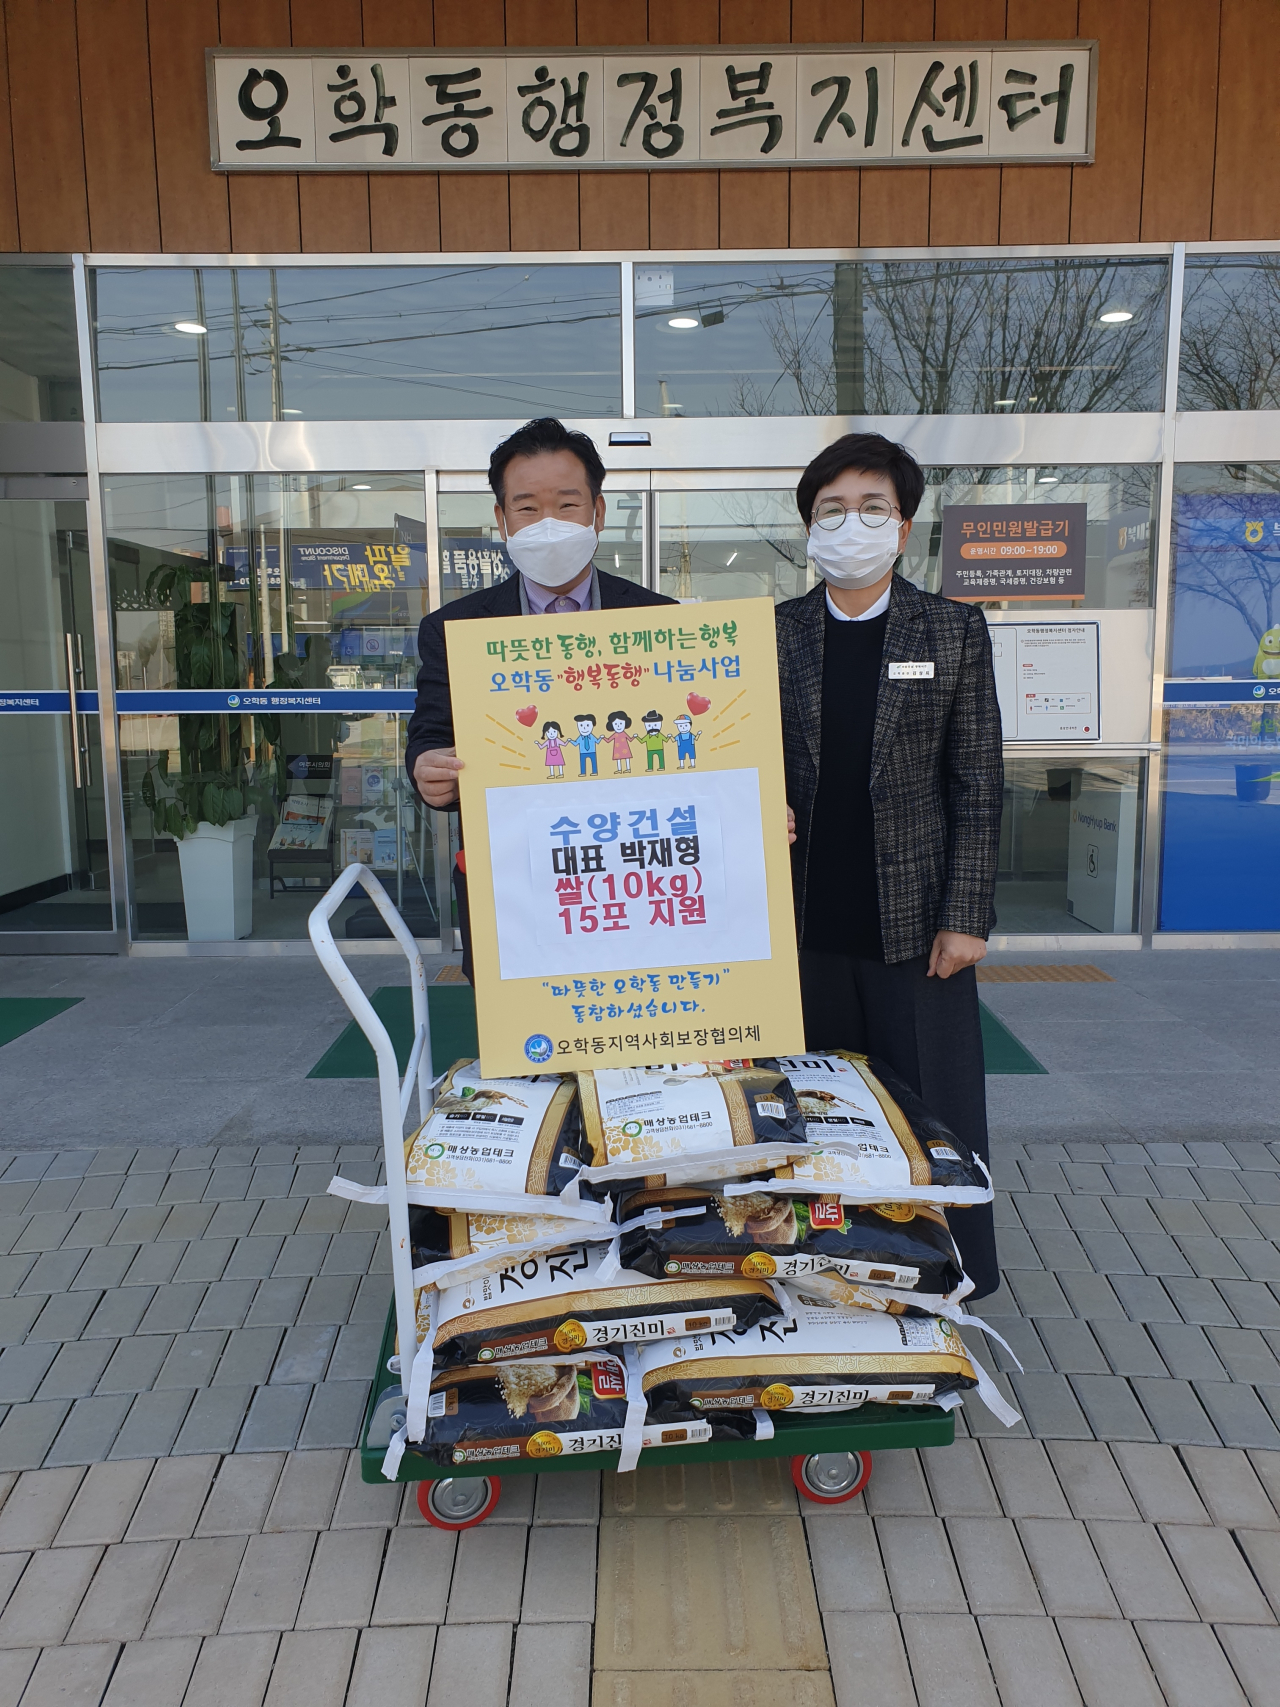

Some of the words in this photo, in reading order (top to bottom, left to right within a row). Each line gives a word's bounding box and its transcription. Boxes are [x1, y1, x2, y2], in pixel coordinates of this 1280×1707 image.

[960, 520, 1069, 538] 무인민원발급기
[970, 547, 996, 555] 운영시간
[1000, 546, 1058, 555] 09:00~19:00
[956, 570, 984, 578] 주민등록,
[986, 569, 1014, 577] 가족관계,
[1016, 569, 1044, 577] 토지대장,
[1046, 568, 1072, 576] 차량관련
[1029, 576, 1056, 585] 건강보험
[1058, 576, 1065, 584] 등
[486, 637, 554, 662] 따뜻한
[557, 633, 602, 661] 동행,
[489, 669, 554, 693] 오학동
[653, 655, 741, 683] 나눔사업
[243, 697, 268, 705] 오학동
[271, 697, 321, 705] 행정복지센터
[550, 805, 698, 846] 수양건설
[1104, 818, 1117, 833] Bank
[551, 844, 606, 876] 대표
[620, 835, 701, 870] 박재형
[555, 866, 703, 906] 쌀(10kg)
[558, 901, 630, 935] 15포
[649, 894, 707, 927] 지원
[613, 973, 661, 994] 오학동
[571, 998, 706, 1024] 동참하셨습니다.
[556, 1024, 761, 1055] 오학동지역사회보장협의체
[644, 1111, 712, 1127] 매상농업테크
[447, 1144, 515, 1157] 매상농업테크
[681, 1262, 735, 1270] 매상농업테크
[592, 1320, 665, 1343] 경기진미
[800, 1389, 869, 1405] 경기진미
[568, 1434, 622, 1450] 경기진
